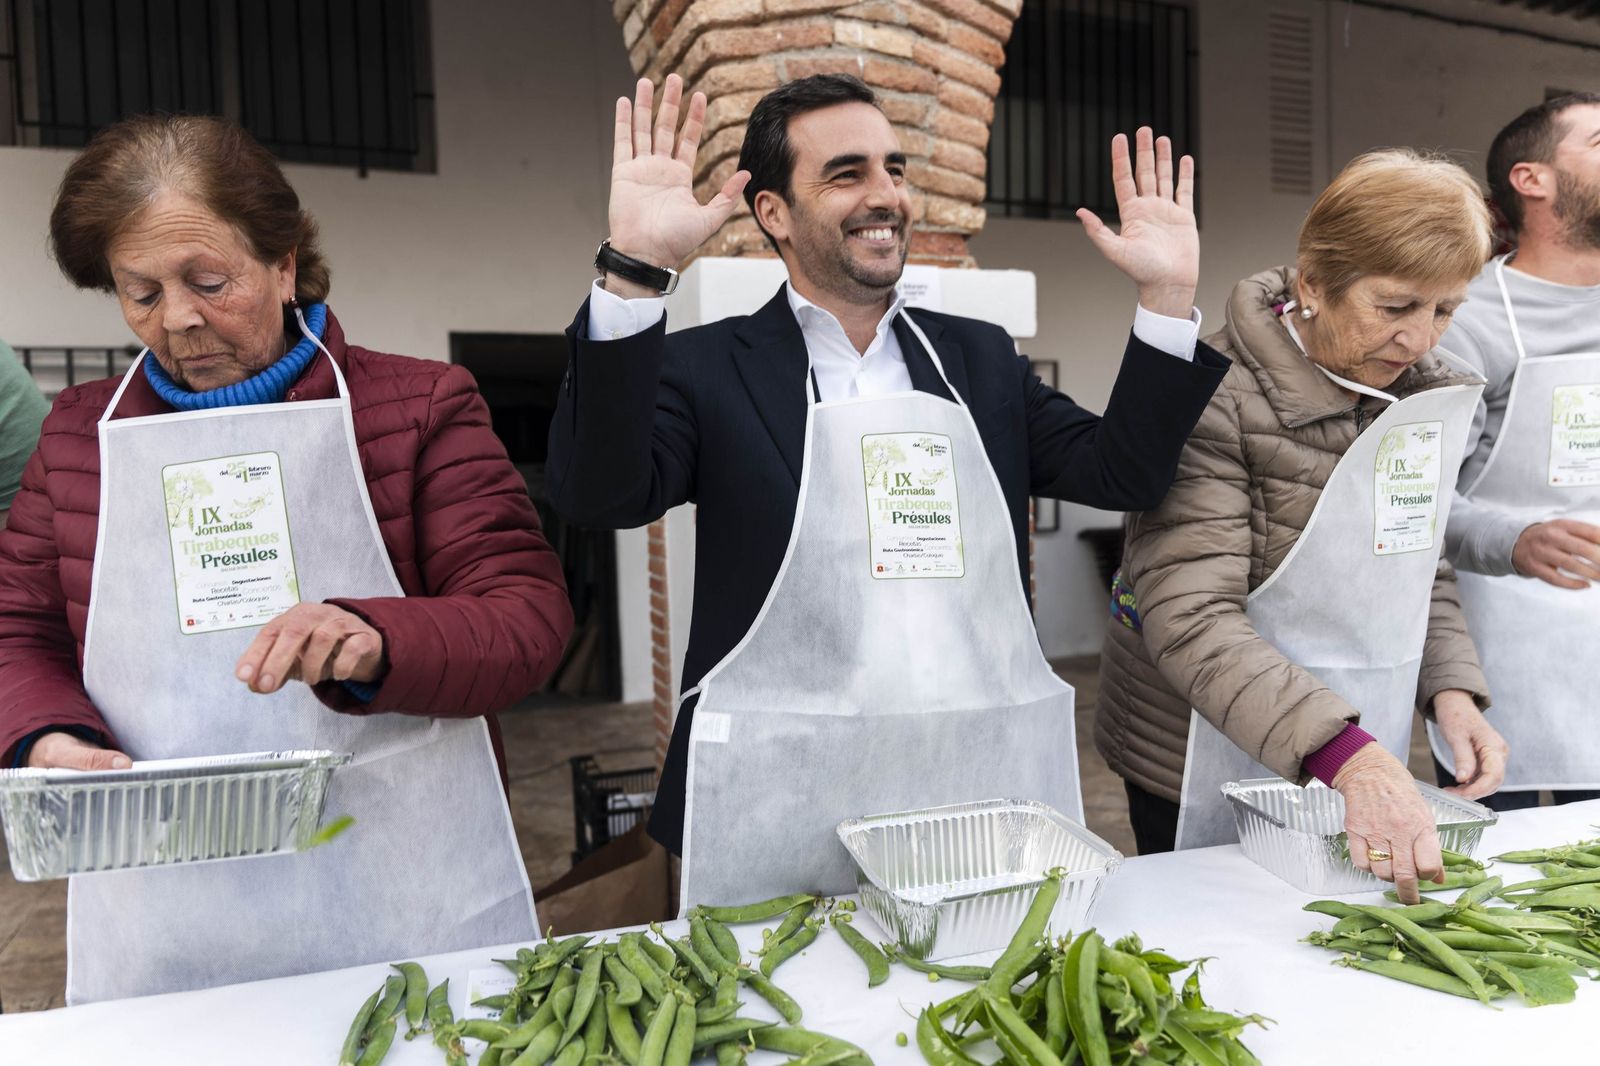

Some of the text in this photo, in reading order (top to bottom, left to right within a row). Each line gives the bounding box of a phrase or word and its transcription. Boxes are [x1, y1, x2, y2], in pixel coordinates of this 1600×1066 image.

[1574, 413, 1586, 424] IX
[226, 461, 246, 476] 25
[1395, 458, 1406, 472] IX
[895, 472, 912, 487] IX
[1389, 472, 1423, 481] Jornadas
[888, 486, 936, 496] Jornadas
[1380, 482, 1436, 495] Tirabeques
[874, 498, 952, 513] Tirabeques
[1391, 493, 1432, 506] Présules
[202, 506, 222, 525] IX
[892, 511, 951, 524] Présules
[195, 520, 253, 537] Jornadas
[179, 532, 280, 556] Tirabeques
[200, 548, 278, 569] Présules
